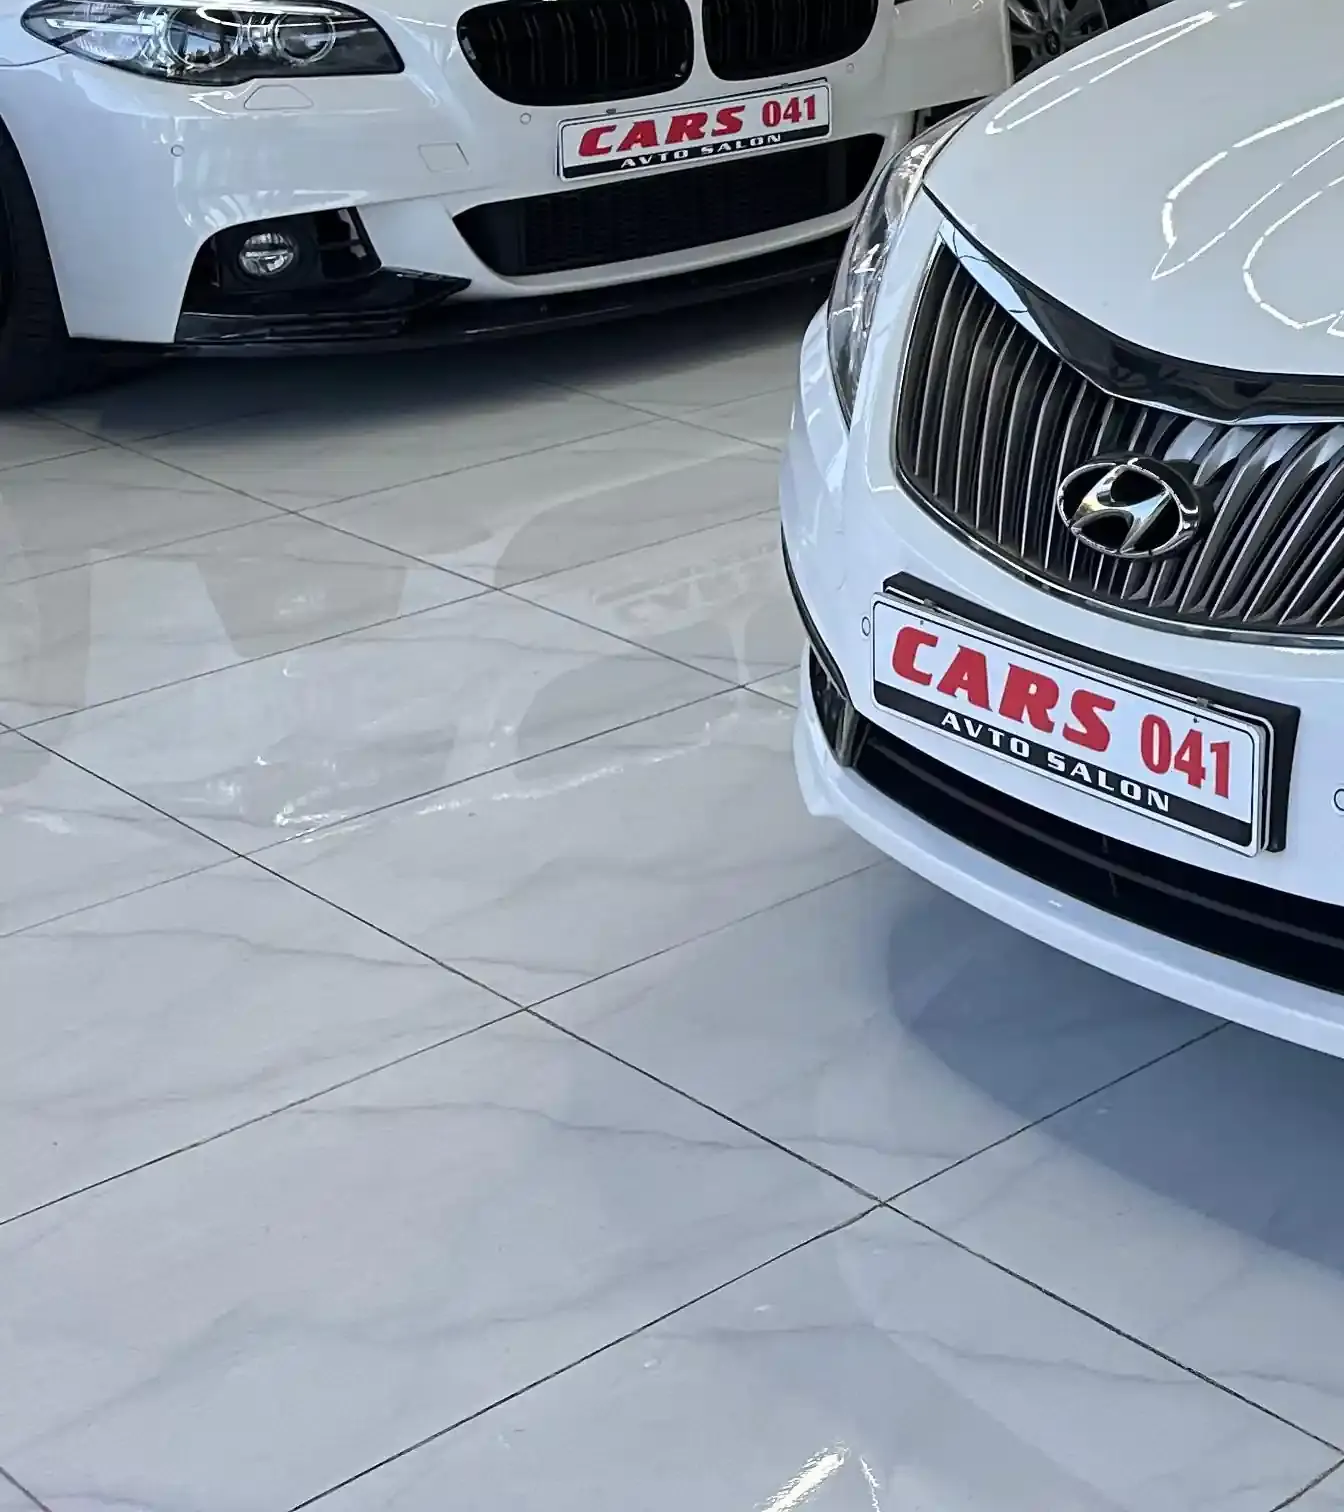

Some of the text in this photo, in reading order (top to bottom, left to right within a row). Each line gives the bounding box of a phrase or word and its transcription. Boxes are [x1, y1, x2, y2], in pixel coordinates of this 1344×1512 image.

[578, 94, 816, 156] CARS 041
[620, 134, 781, 169] AVTO SALON
[891, 626, 1230, 798] CARS 041
[940, 711, 1170, 812] AVTO SALON
